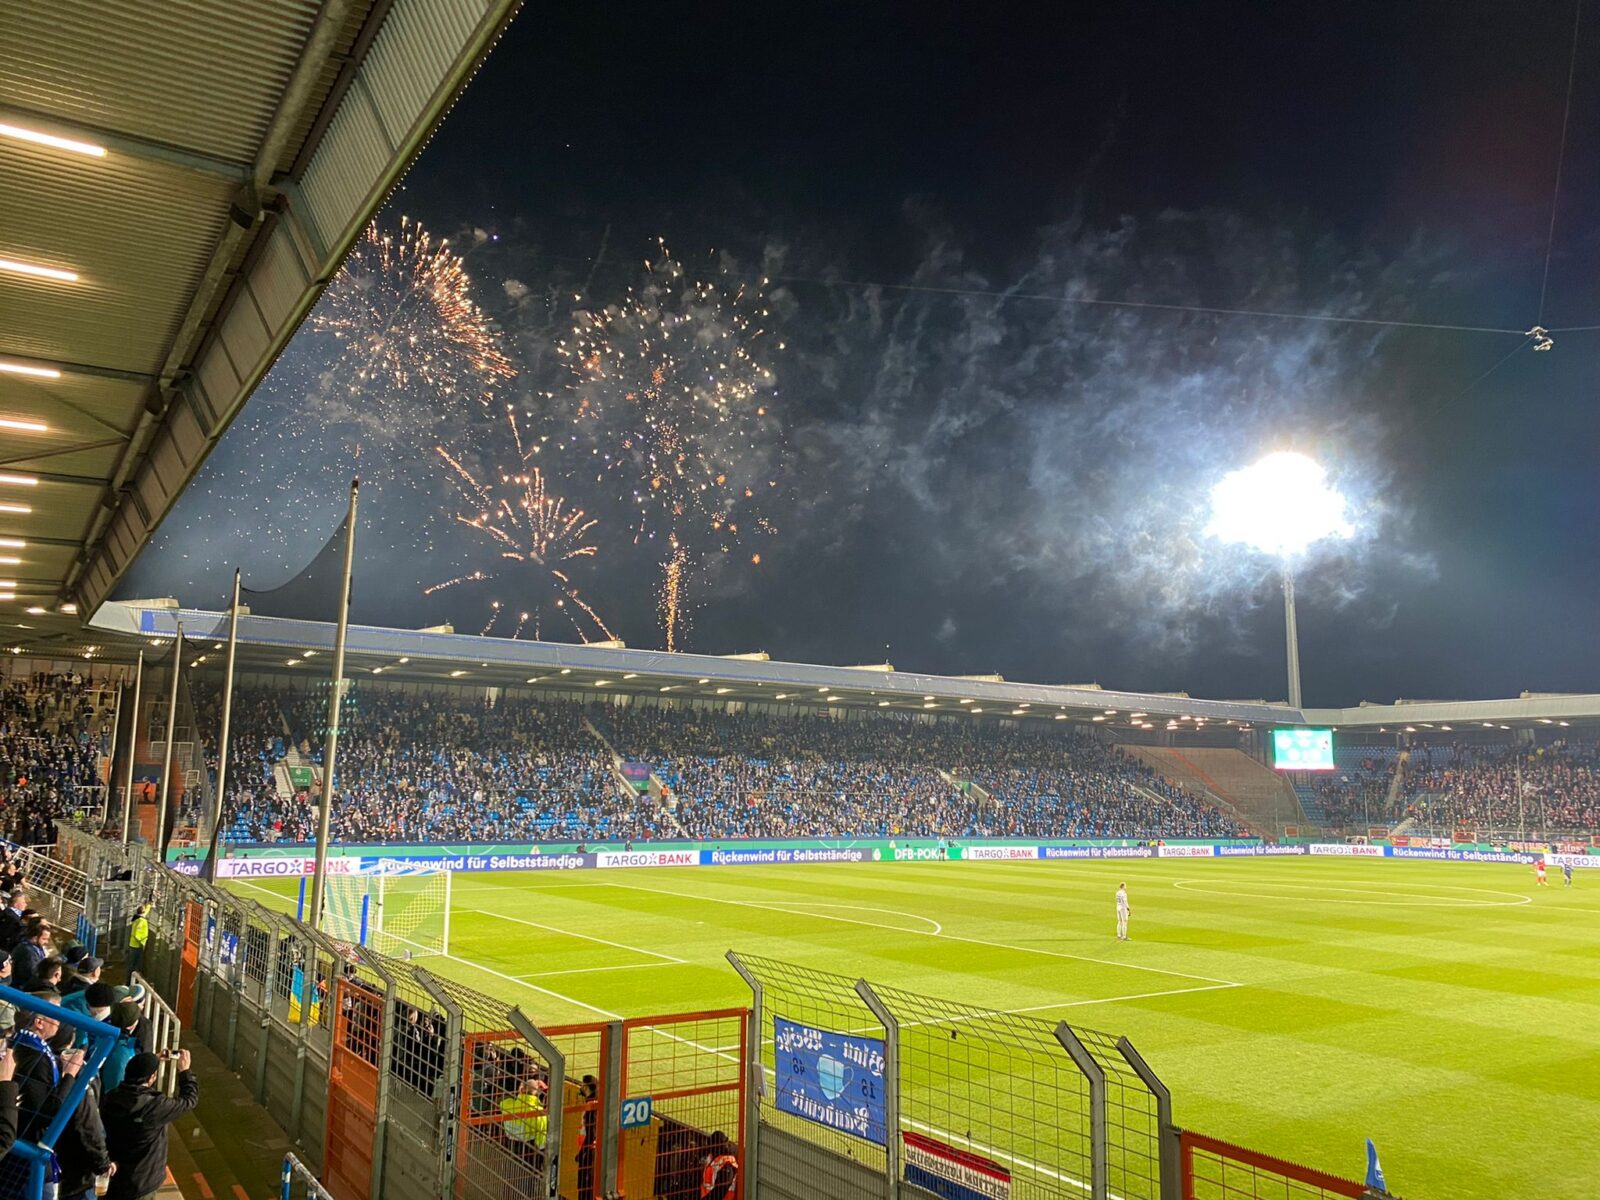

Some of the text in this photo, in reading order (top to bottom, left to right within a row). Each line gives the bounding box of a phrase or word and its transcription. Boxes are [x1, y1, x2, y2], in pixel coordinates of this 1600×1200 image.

[712, 849, 862, 863] Rückenwind für Selbstständige
[1045, 847, 1152, 857] Rückenwind für Selbstständige
[1256, 845, 1265, 855] für
[1392, 847, 1534, 864] Rückenwind für Selbstständige
[303, 860, 350, 873] BNK
[467, 856, 488, 869] für
[490, 855, 584, 869] Selbstständige
[623, 1100, 649, 1124] 20
